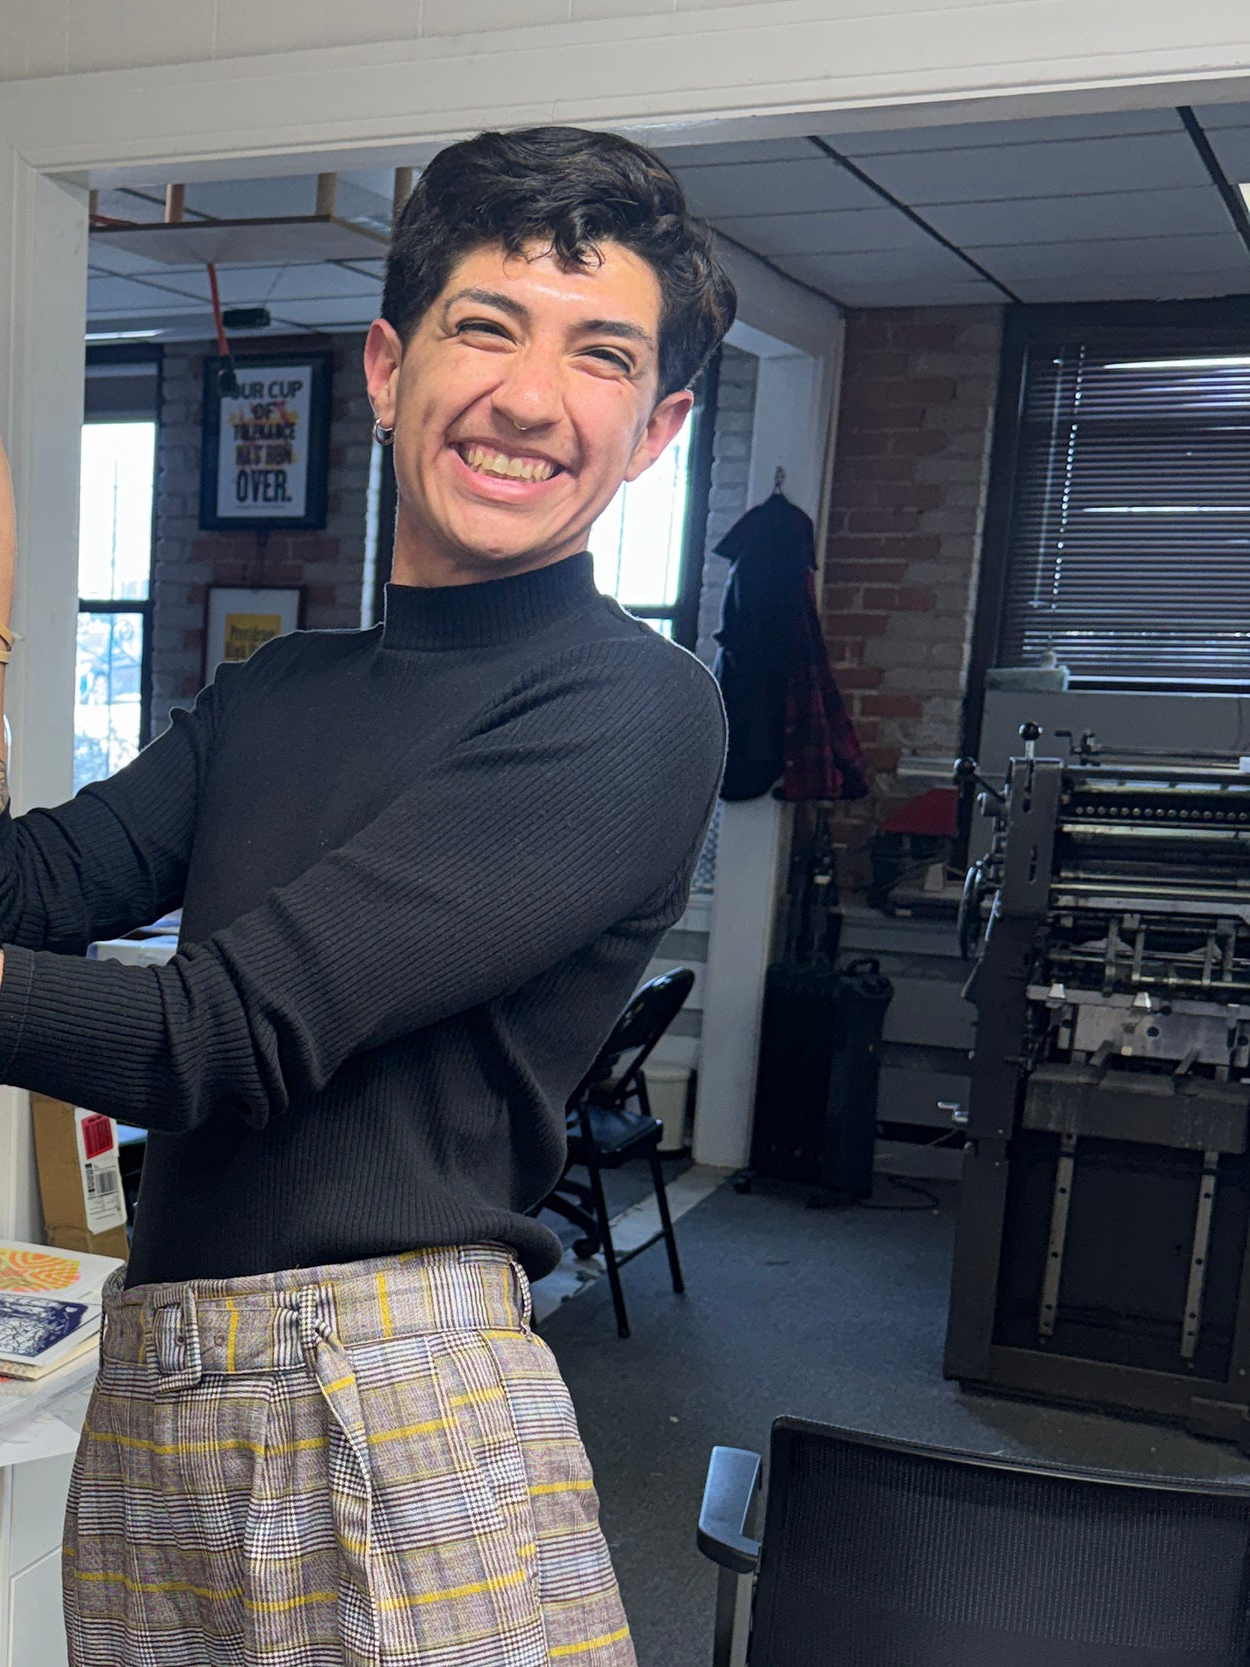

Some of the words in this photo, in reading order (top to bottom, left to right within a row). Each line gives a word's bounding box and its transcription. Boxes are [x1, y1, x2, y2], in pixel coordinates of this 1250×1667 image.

[268, 380, 302, 398] CUP
[253, 402, 276, 420] OF
[236, 469, 292, 502] OVER.
